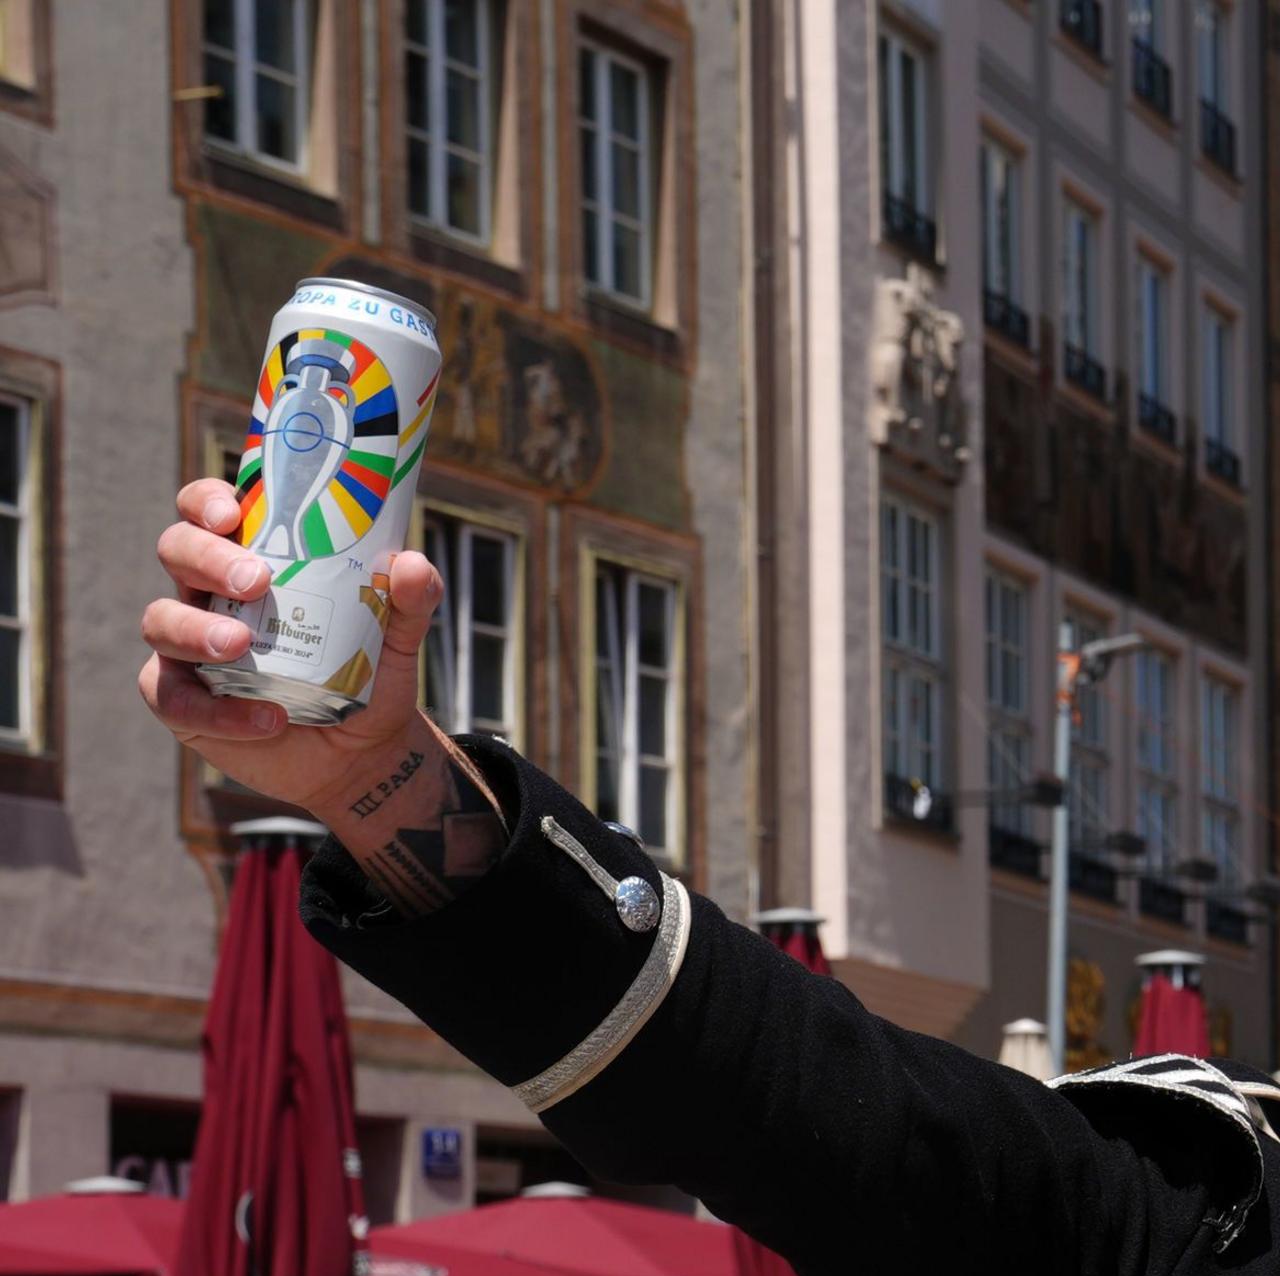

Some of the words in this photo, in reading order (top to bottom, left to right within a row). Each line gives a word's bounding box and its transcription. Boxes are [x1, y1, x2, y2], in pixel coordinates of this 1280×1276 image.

[348, 298, 380, 315] ZU
[347, 557, 363, 571] TM
[266, 617, 323, 645] Bitburger
[378, 751, 425, 798] PARA
